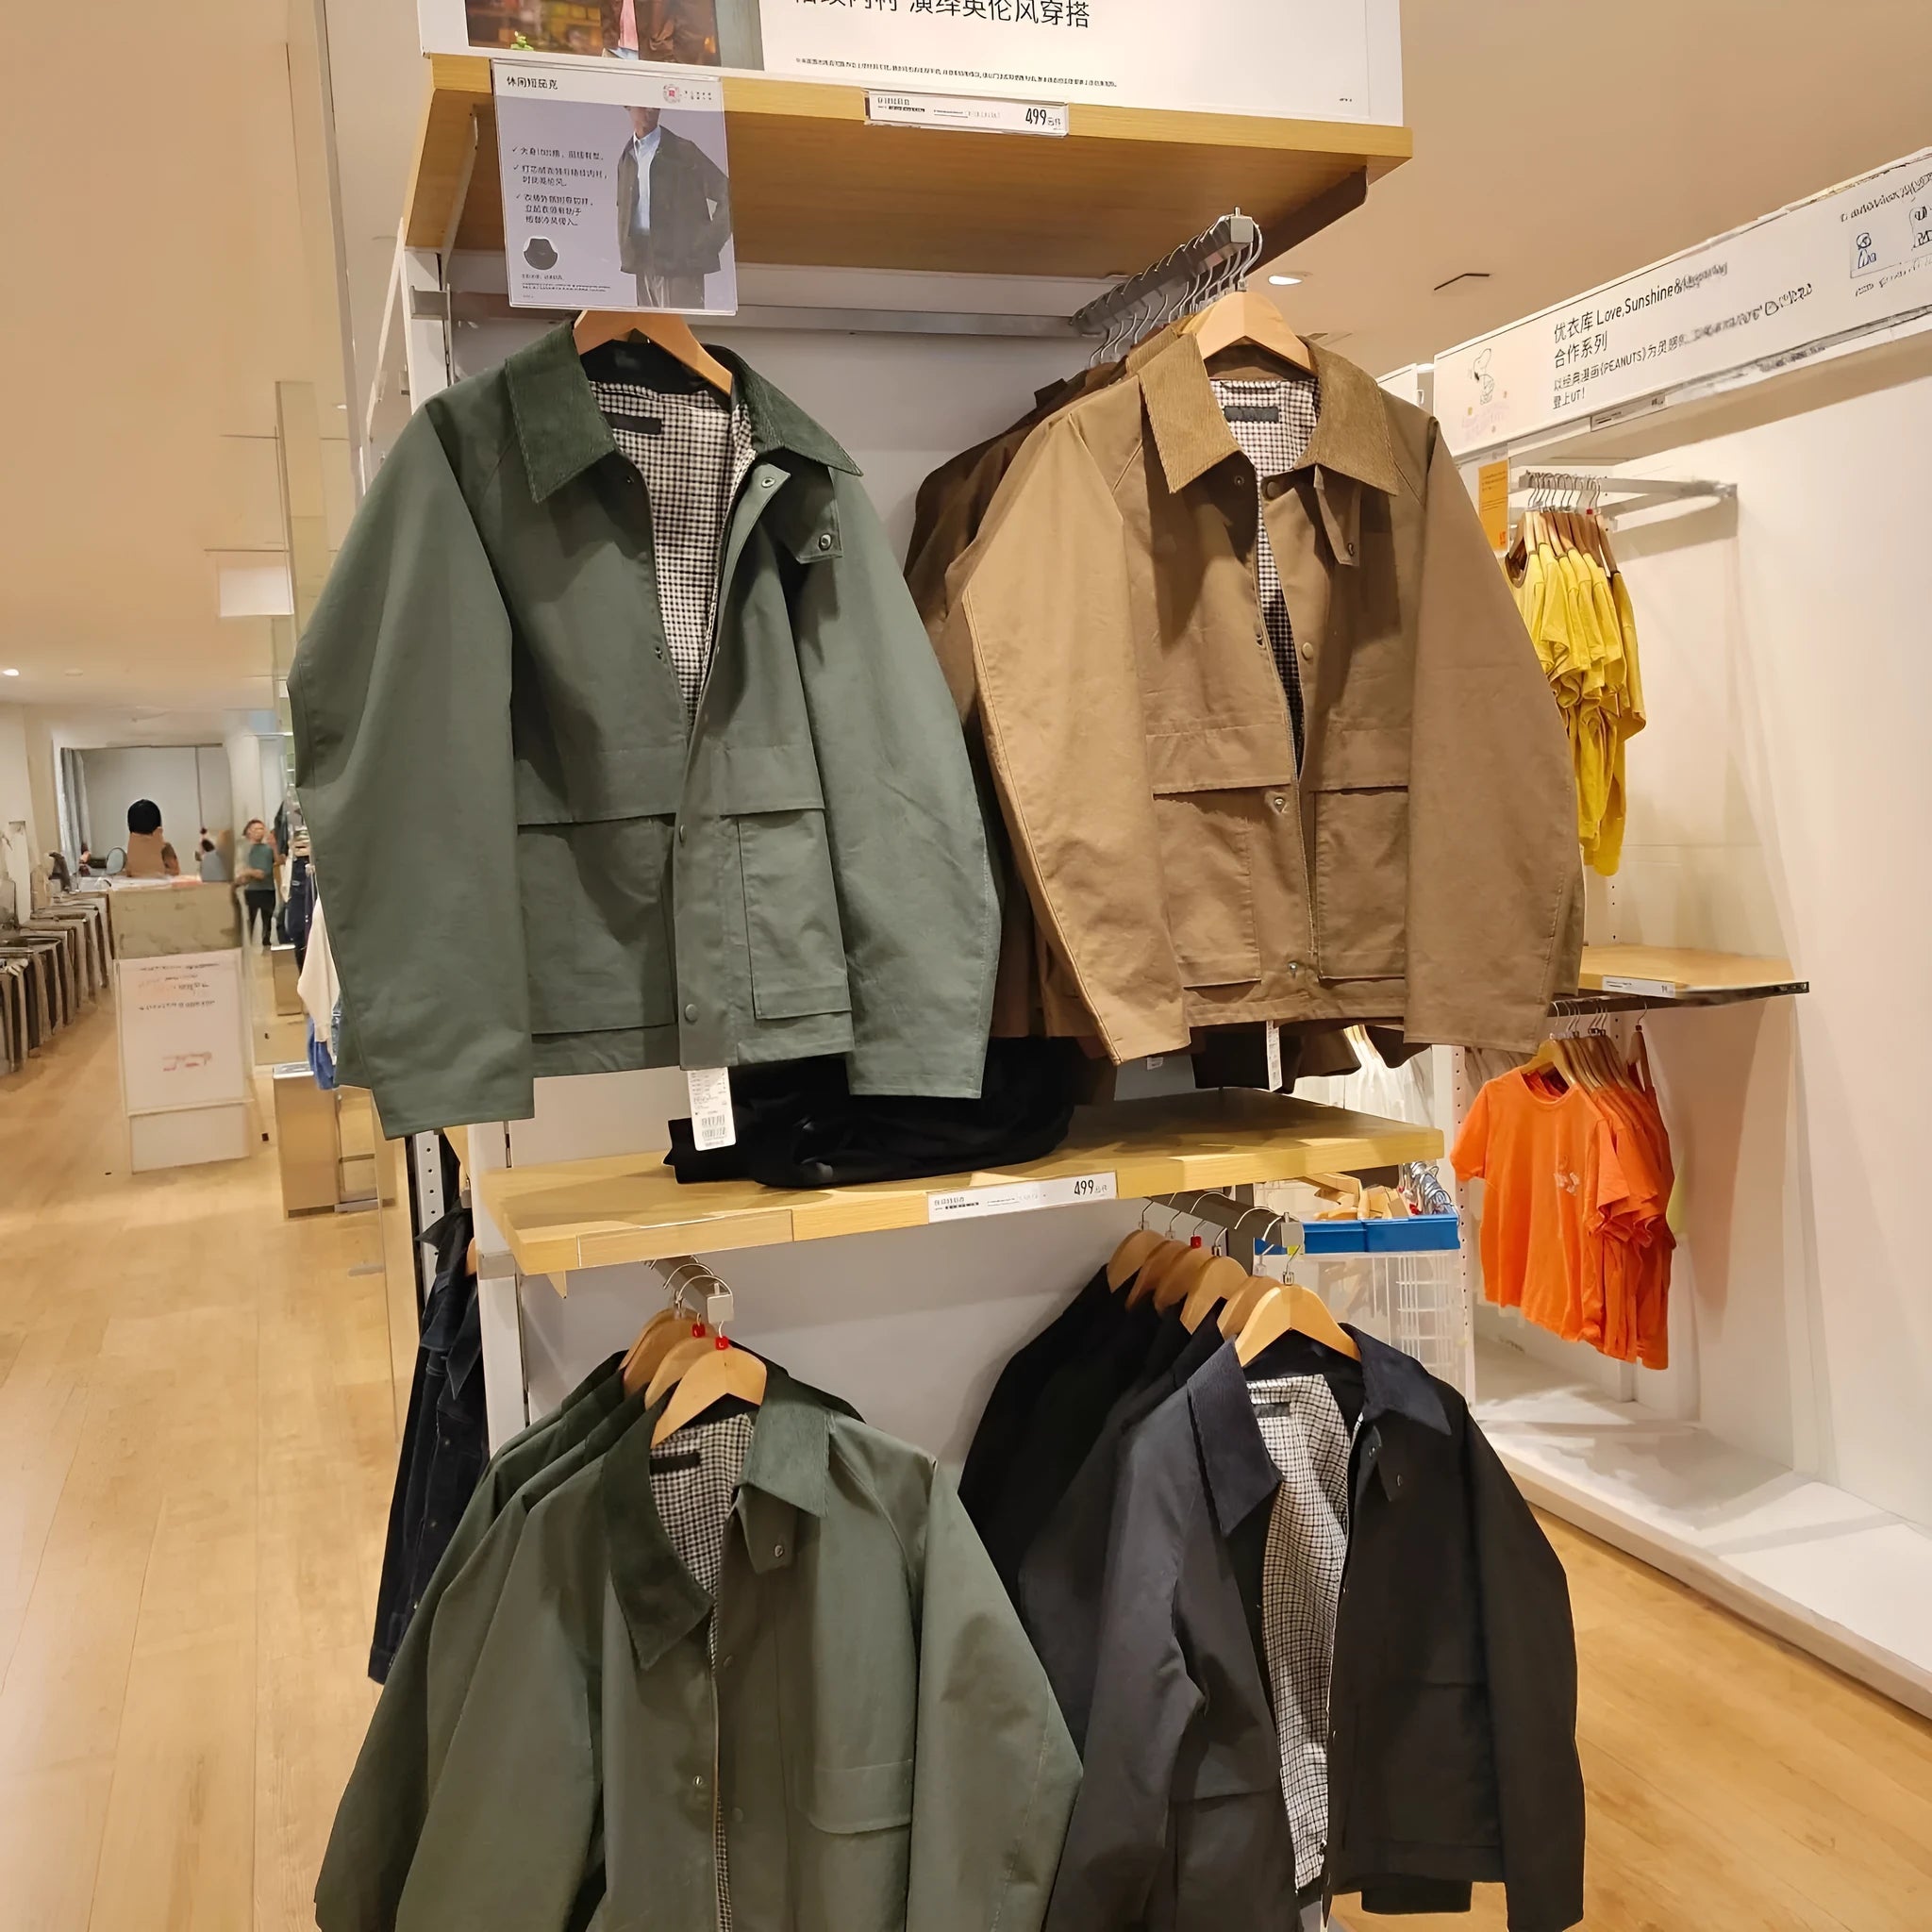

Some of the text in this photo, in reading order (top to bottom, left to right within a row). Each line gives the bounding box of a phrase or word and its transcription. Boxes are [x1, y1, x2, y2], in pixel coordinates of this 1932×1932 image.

[1024, 108, 1047, 125] 499
[1554, 311, 1593, 343] 优衣库
[1554, 330, 1607, 368] 合作系列
[1074, 1179, 1094, 1196] 499
